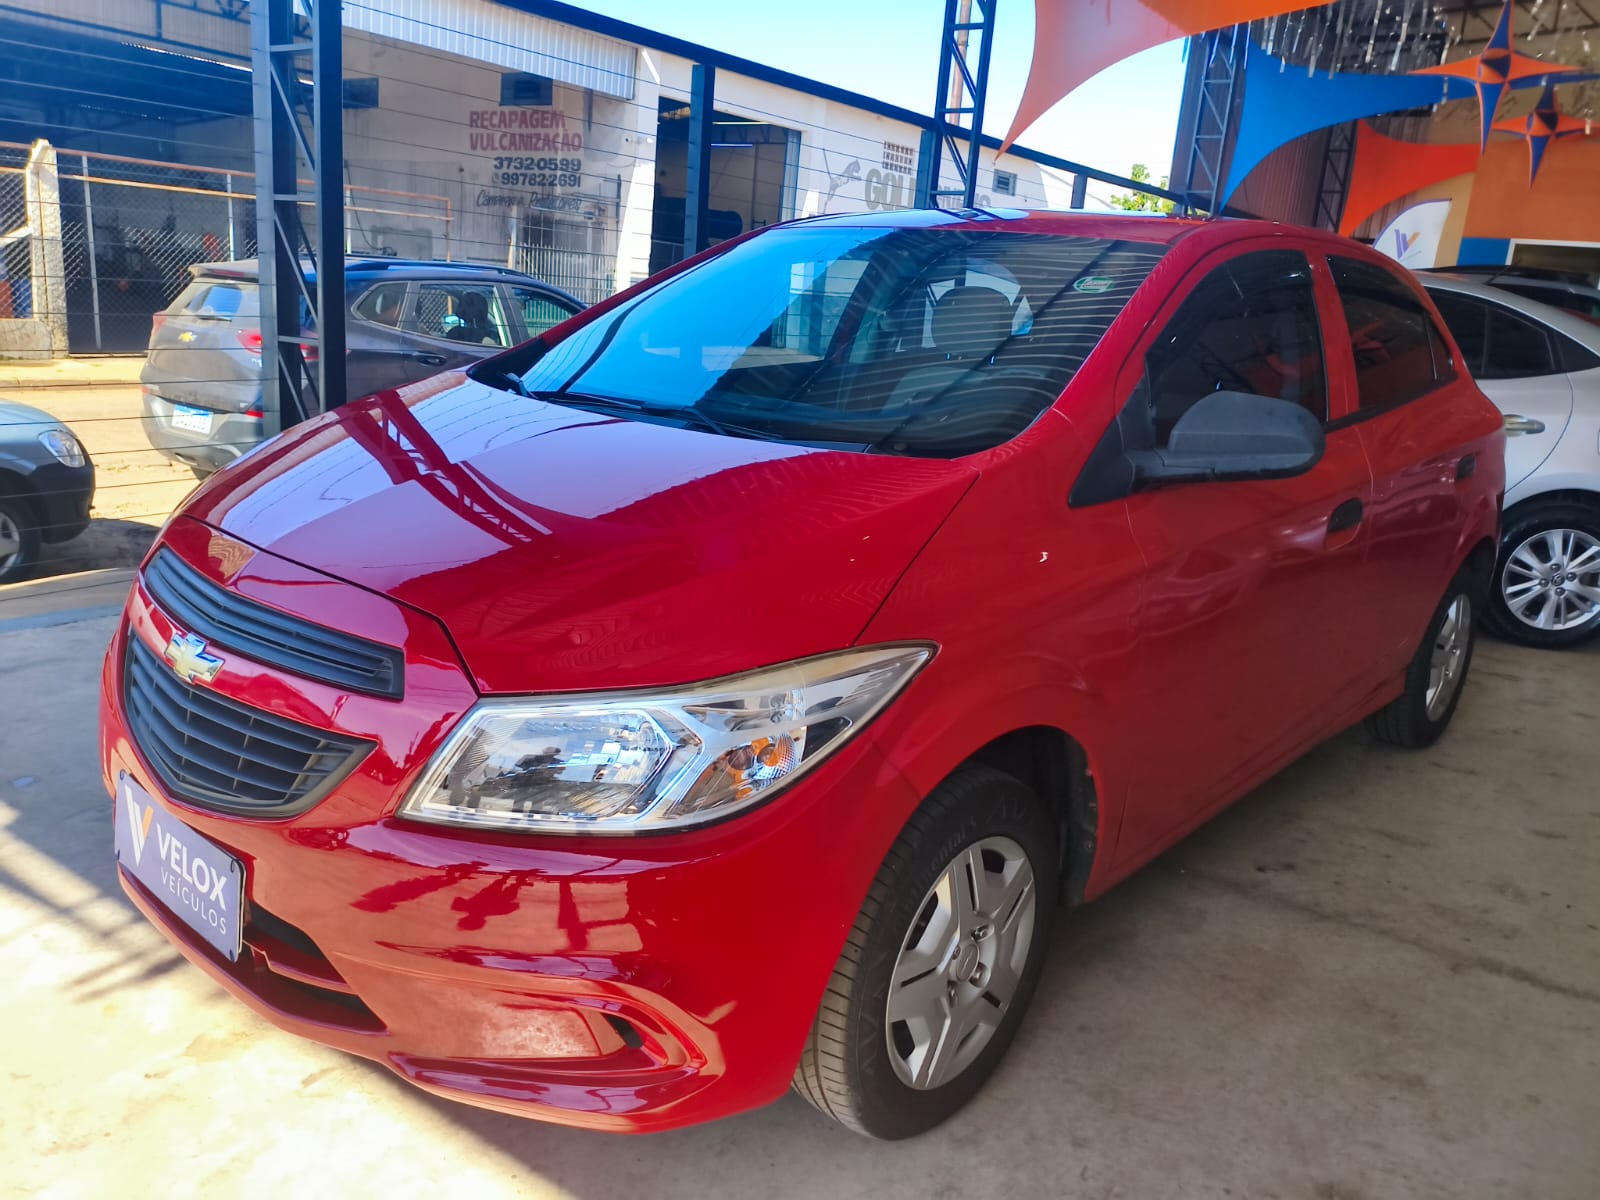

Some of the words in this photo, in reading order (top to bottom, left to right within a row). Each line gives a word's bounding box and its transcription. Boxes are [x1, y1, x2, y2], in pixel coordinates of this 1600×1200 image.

[469, 110, 566, 129] RECAPAGEM
[469, 130, 583, 153] VULCANIZAÇÃO
[156, 823, 228, 913] VELOX
[160, 867, 227, 936] VEÍCULOS
